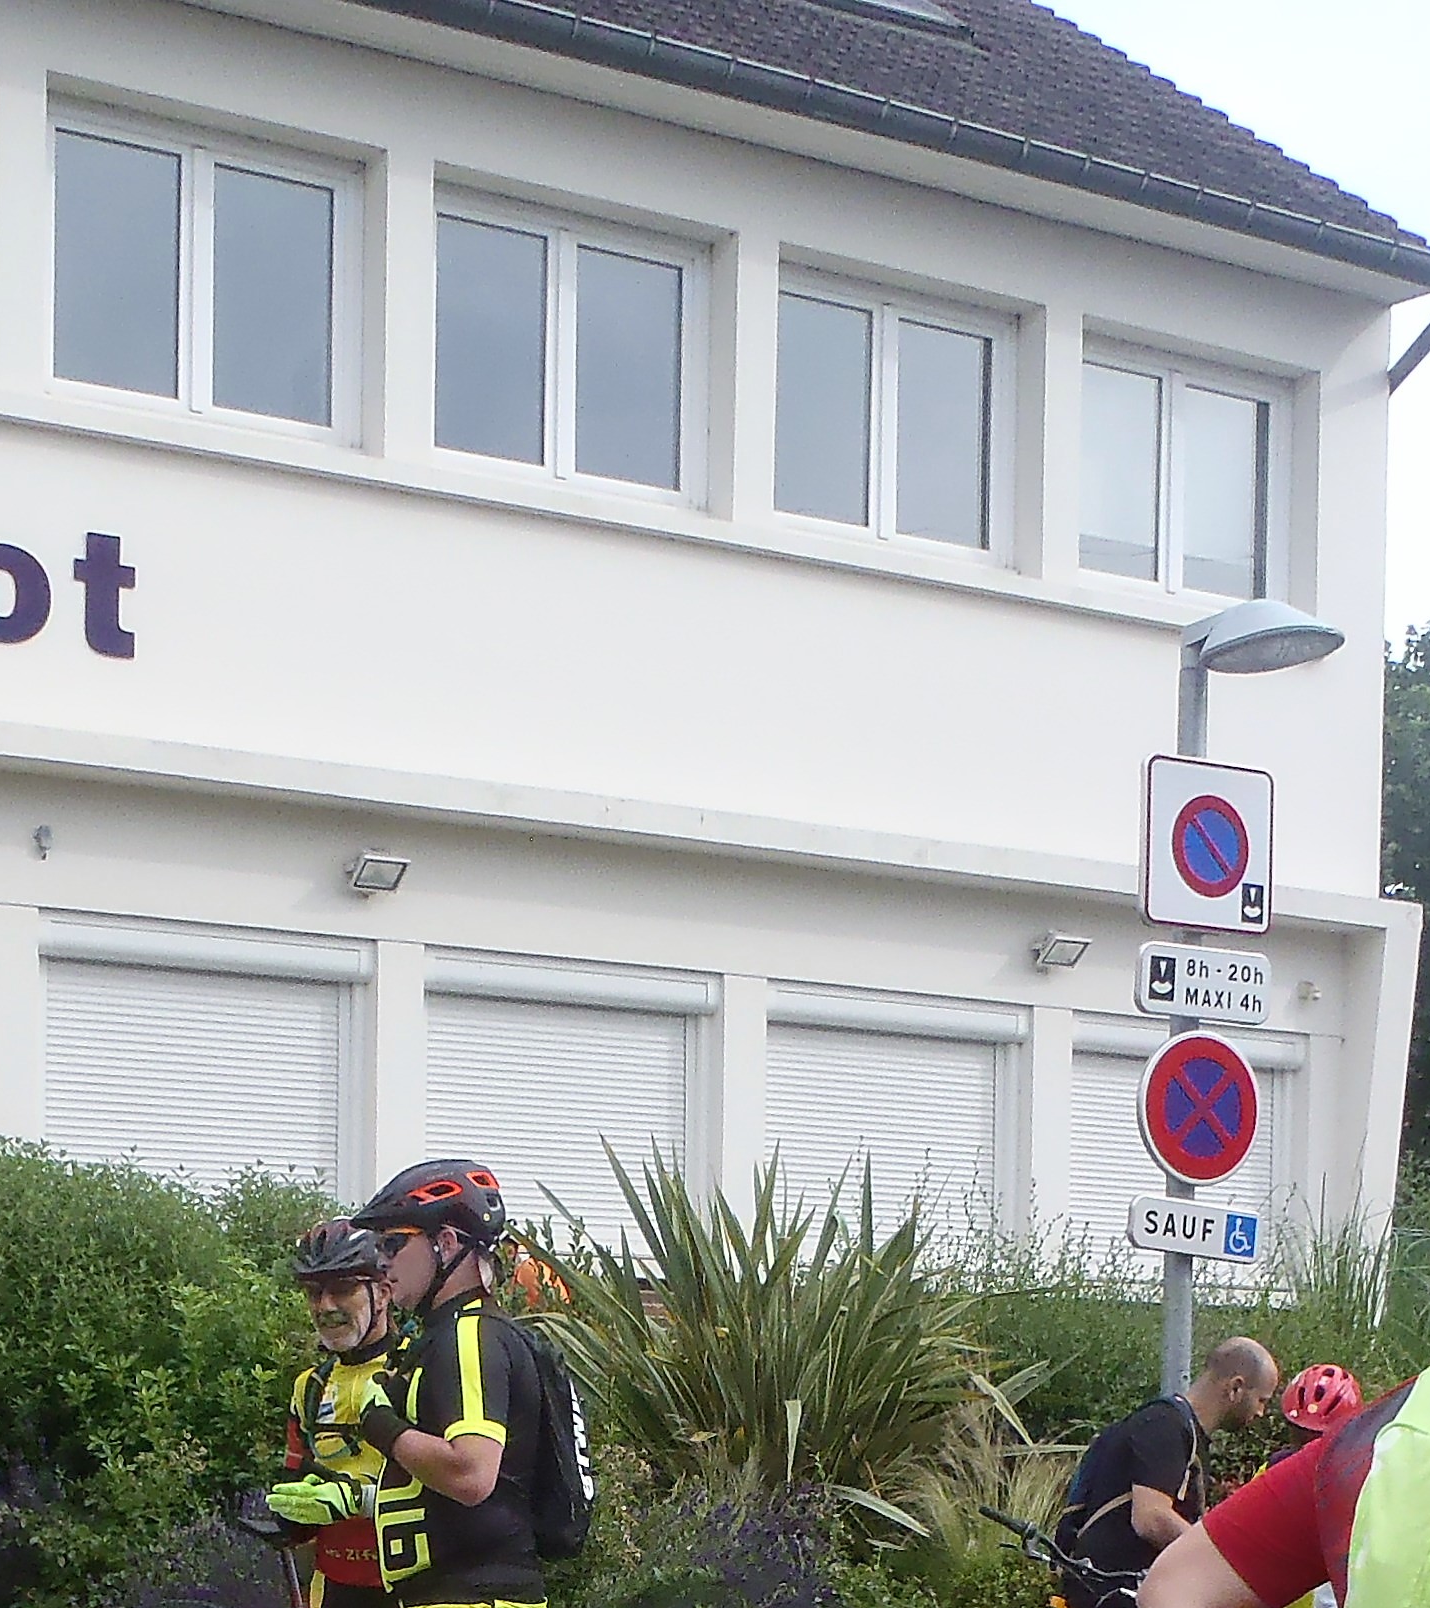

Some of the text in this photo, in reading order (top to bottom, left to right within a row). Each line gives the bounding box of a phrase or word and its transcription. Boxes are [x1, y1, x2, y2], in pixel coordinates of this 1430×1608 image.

[1185, 958, 1209, 979] 8h
[1228, 964, 1264, 986] 20h
[1184, 987, 1263, 1014] MAXI 4h
[1143, 1210, 1216, 1243] SAUF
